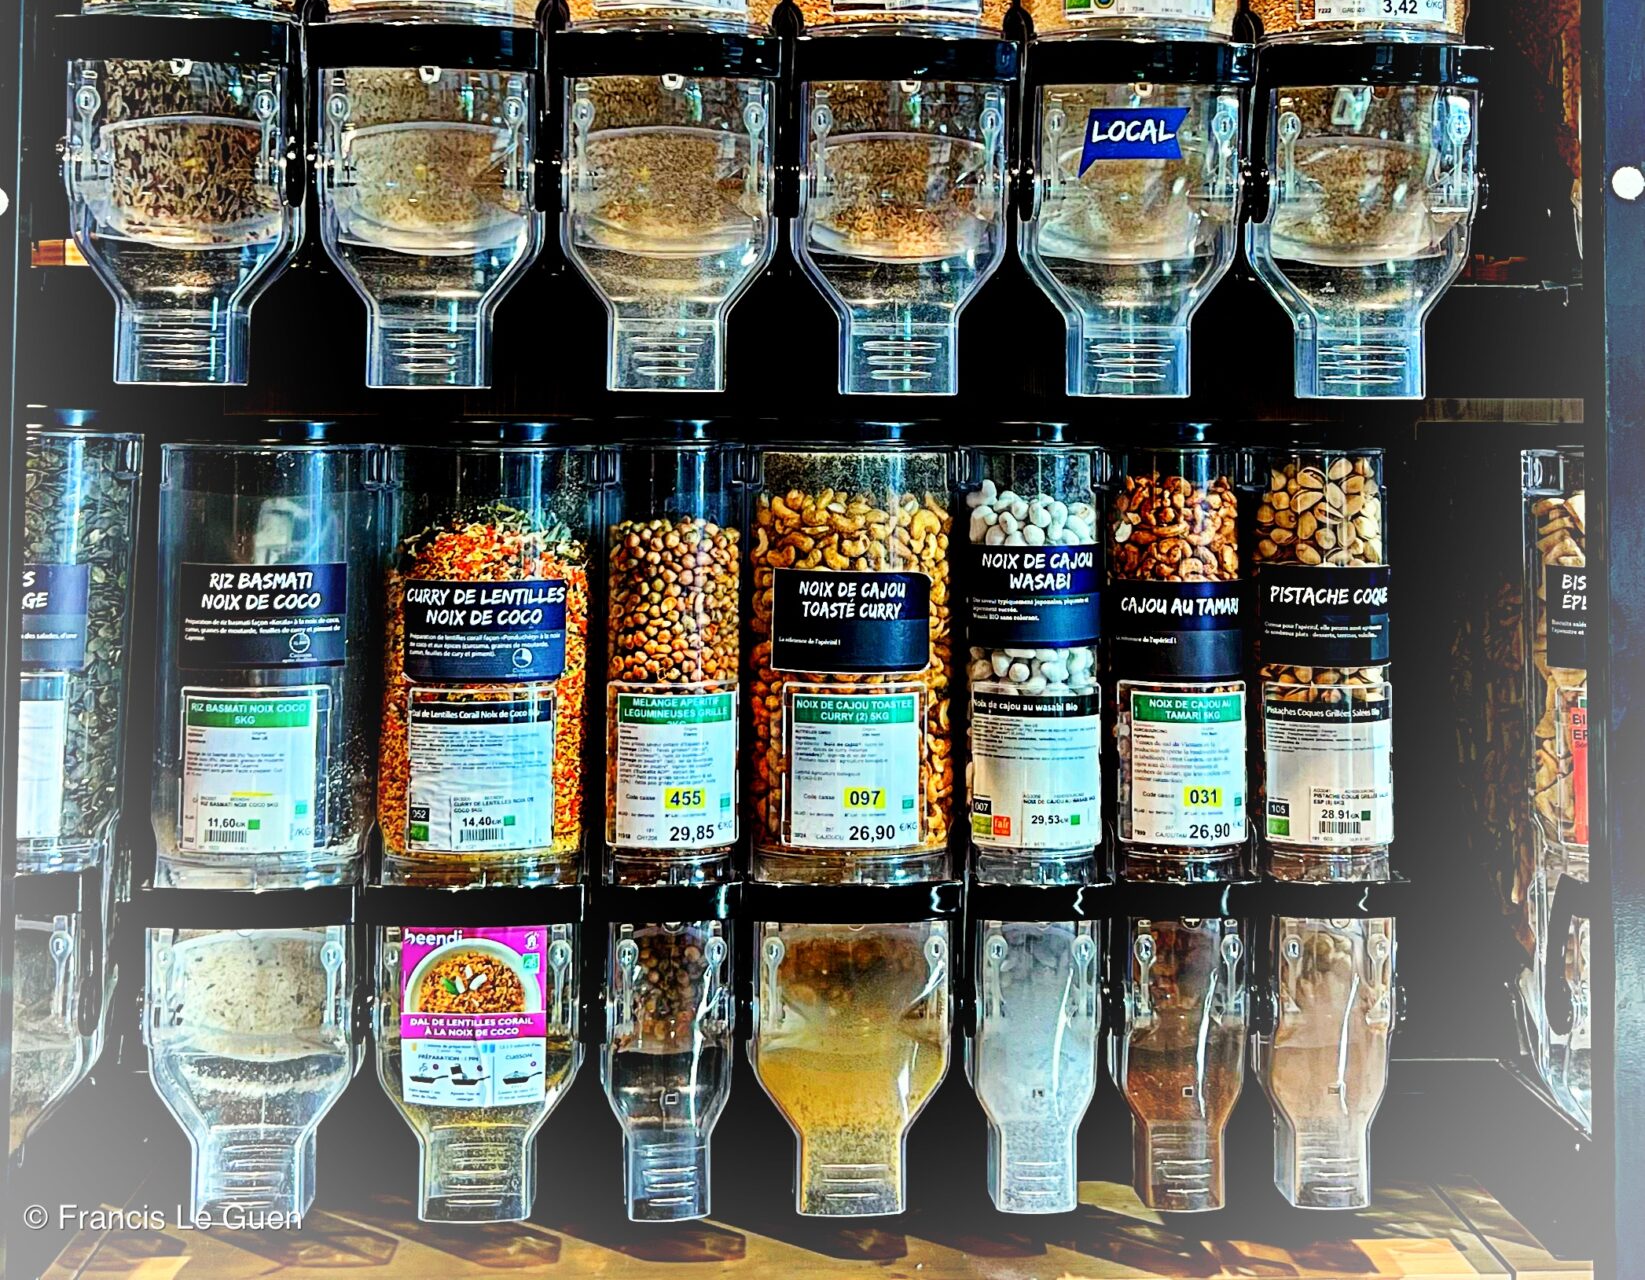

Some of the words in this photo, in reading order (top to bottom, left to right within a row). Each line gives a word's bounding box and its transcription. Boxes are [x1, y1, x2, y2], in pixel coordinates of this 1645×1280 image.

[1091, 118, 1176, 145] LOCAL
[982, 553, 1019, 569] NOIX
[1023, 554, 1046, 569] DE
[1050, 552, 1093, 570] CAJOU
[209, 573, 235, 590] RIZ
[238, 572, 313, 590] BASMATI
[1010, 573, 1072, 591] WASABI
[407, 587, 450, 606] CURRY
[454, 588, 477, 605] DE
[480, 587, 566, 606] LENTILLES
[799, 581, 834, 597] NOIX
[838, 582, 857, 598] DE
[861, 582, 906, 599] CAJOU
[1270, 585, 1349, 606] PISTACHE
[201, 594, 242, 610] NOIX
[245, 594, 269, 610] DE
[273, 593, 322, 610] COCO
[802, 598, 855, 619] TOASTÉ
[859, 602, 902, 620] CURRY
[1121, 597, 1167, 615] CAJOU
[1171, 598, 1193, 616] AU
[426, 609, 467, 626] NOIX
[470, 610, 493, 625] DE
[497, 608, 543, 625] COCO
[191, 703, 203, 712] RIZ
[206, 703, 247, 713] BASMATI
[251, 703, 274, 713] NOIX
[276, 703, 306, 712] COCO
[633, 698, 678, 707] MELANGE
[680, 697, 719, 707] APERITIF
[797, 700, 818, 709] NOIX
[821, 701, 833, 710] DE
[836, 701, 869, 710] CAJOU
[872, 699, 913, 709] TOASTEE
[988, 701, 997, 709] de
[1000, 702, 1021, 712] cajou
[1036, 702, 1064, 712] wasabi
[1066, 703, 1078, 712] Bio
[1150, 699, 1172, 708] NOIX
[1175, 700, 1188, 708] DE
[1191, 700, 1221, 708] CAJOU
[1223, 700, 1231, 708] AU
[422, 709, 430, 718] de
[431, 710, 458, 718] Lentilles
[459, 710, 480, 718] Corail
[481, 710, 498, 718] Noix
[499, 710, 509, 718] de
[510, 709, 528, 718] Coco
[624, 708, 696, 718] LEGUMINEUSES
[821, 712, 853, 720] CURRY
[856, 711, 868, 721] (2)
[871, 711, 889, 720] 5KG
[1165, 711, 1201, 719] TAMARI
[1204, 711, 1220, 719] 5KG
[1266, 706, 1296, 716] Pistaches
[1297, 708, 1324, 718] Coques
[234, 715, 256, 725] 5KG
[670, 791, 701, 806] 455
[850, 790, 880, 806] 097
[1190, 789, 1217, 804] 031
[975, 802, 988, 811] 007
[670, 824, 714, 842] 29,85
[849, 824, 895, 842] 26,90
[1189, 823, 1230, 840] 26,90
[405, 928, 463, 946] beendi
[410, 1018, 430, 1026] DAL
[432, 1018, 444, 1026] DE
[446, 1019, 496, 1027] LENTILLES
[425, 1028, 432, 1036] À
[476, 1029, 489, 1037] DE
[490, 1028, 519, 1036] COCO
